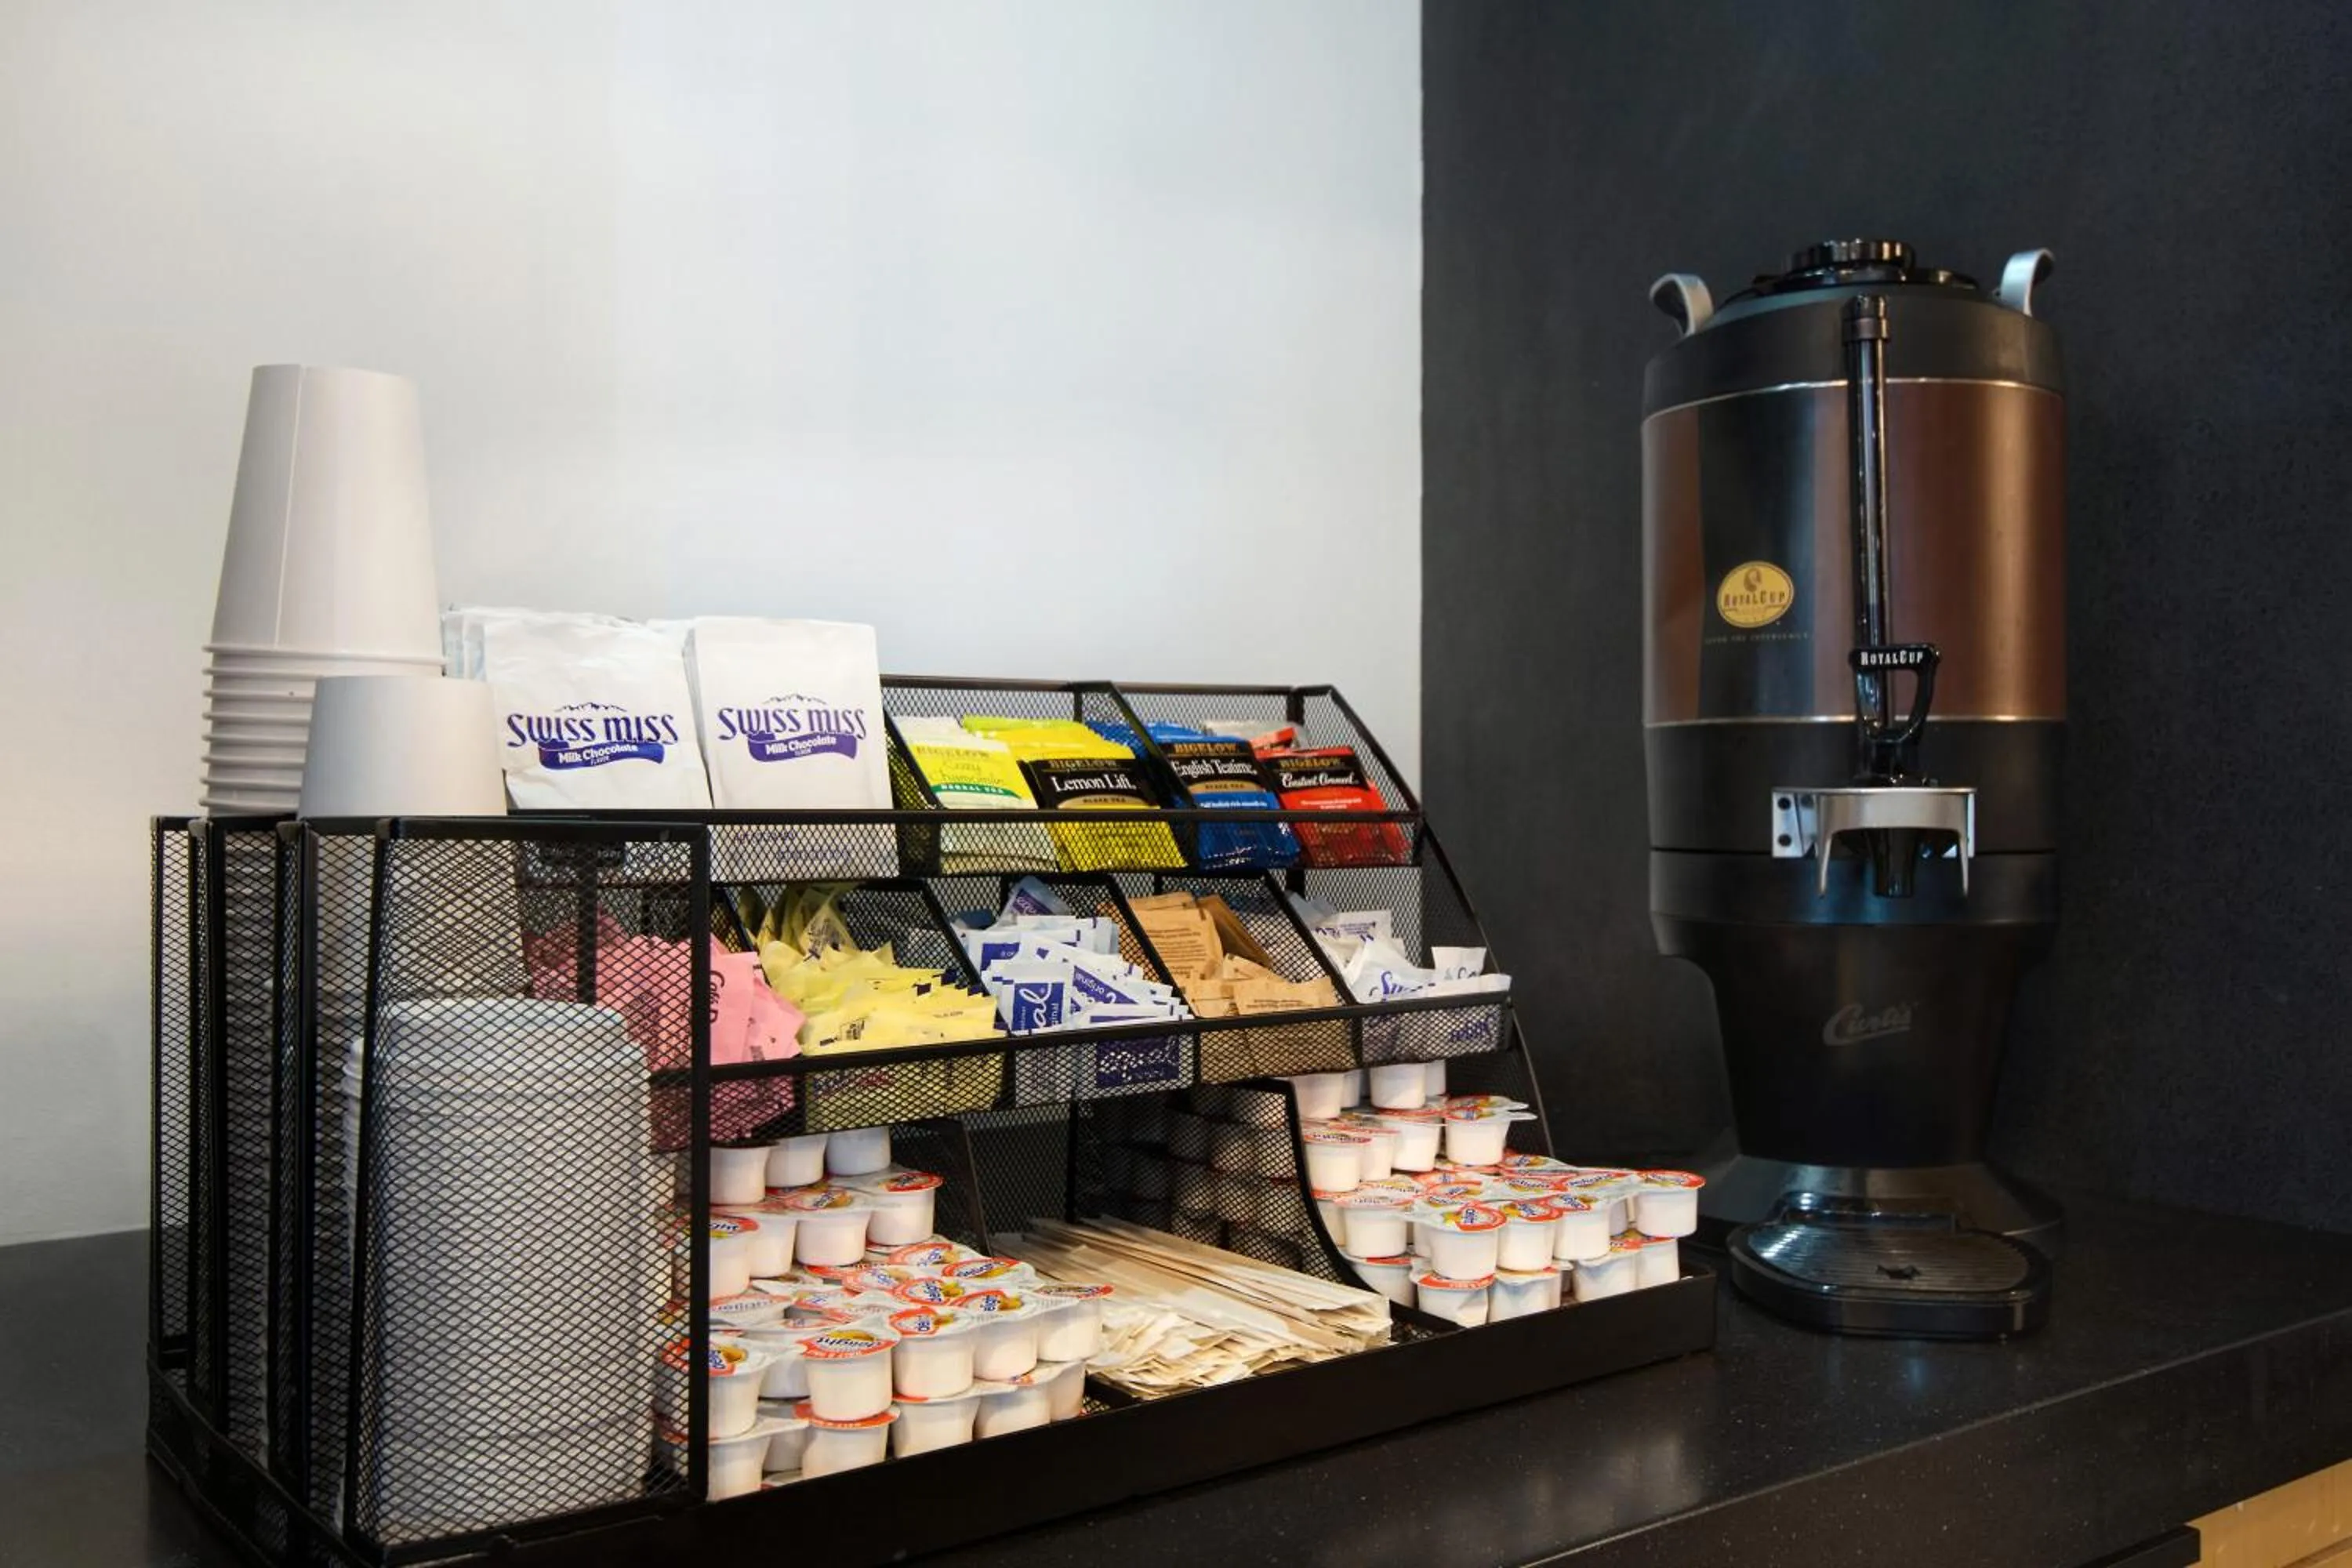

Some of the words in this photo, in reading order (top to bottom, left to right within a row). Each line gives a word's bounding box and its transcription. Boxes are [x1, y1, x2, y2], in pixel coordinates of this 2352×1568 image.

[1860, 650, 1924, 666] ROYALCUP
[558, 750, 583, 764] Milk
[583, 743, 639, 762] Chocolate
[764, 743, 787, 756] Milk
[787, 735, 837, 751] Chocolate
[1170, 759, 1215, 779] English
[1050, 775, 1105, 793] Lemon
